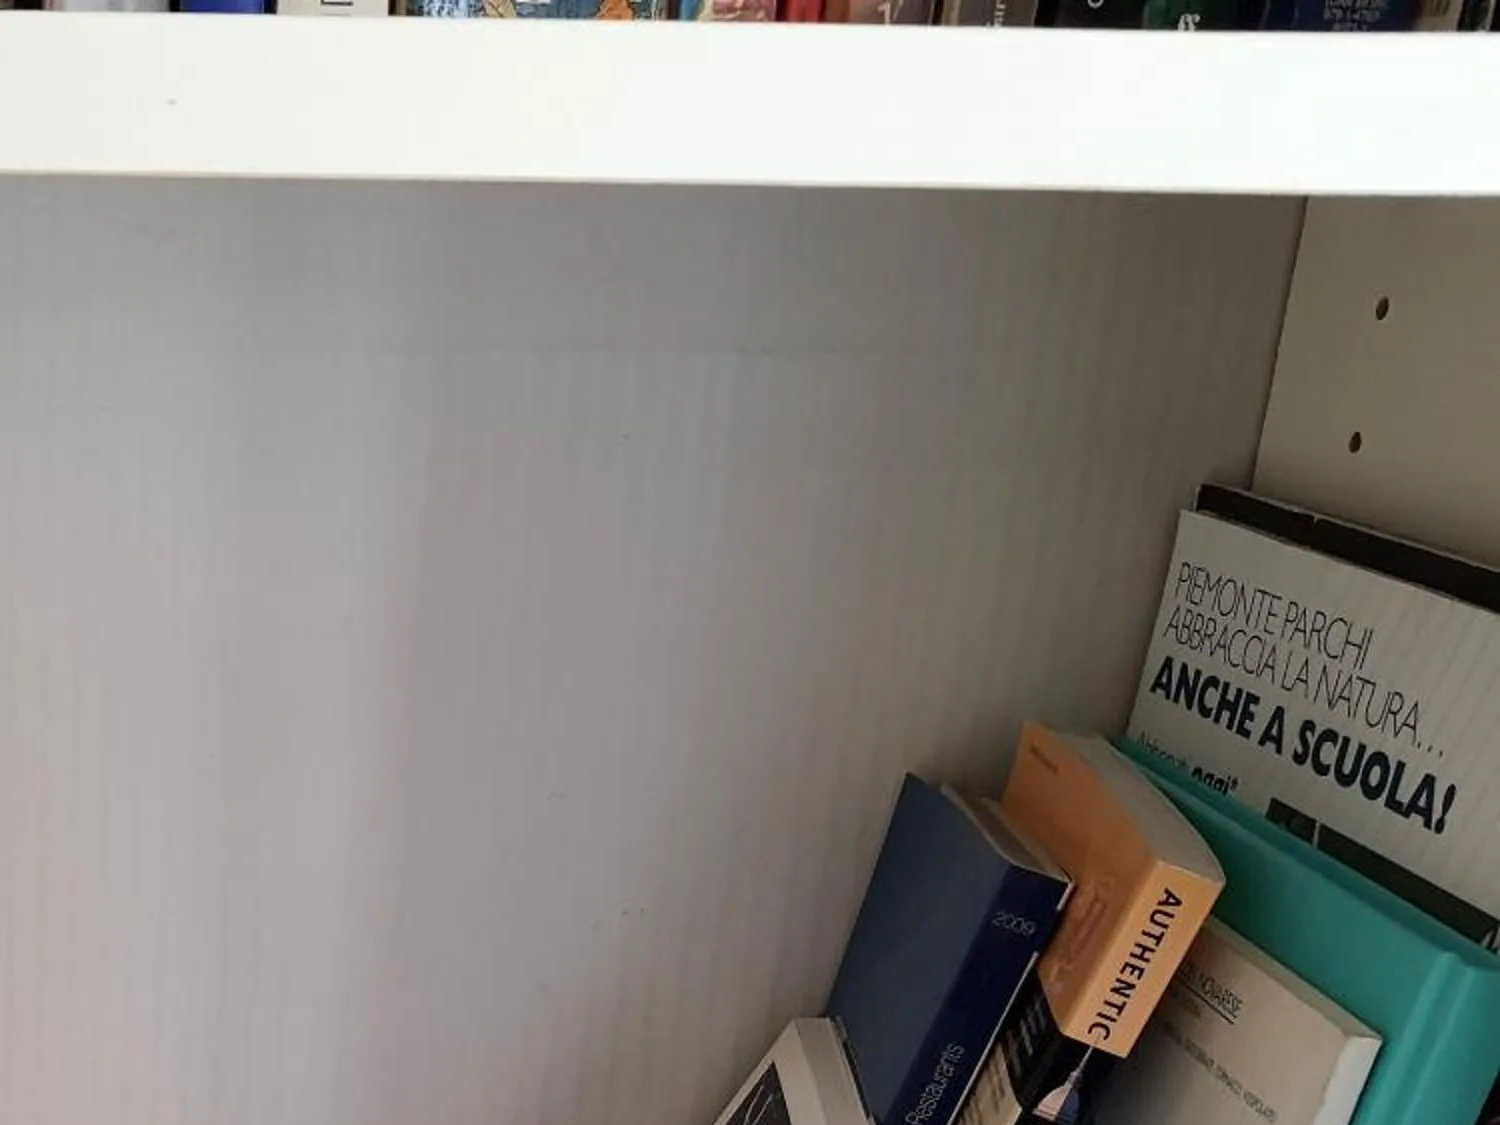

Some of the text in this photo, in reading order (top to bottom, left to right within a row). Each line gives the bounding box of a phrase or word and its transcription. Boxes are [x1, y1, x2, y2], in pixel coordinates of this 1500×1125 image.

[1162, 603, 1277, 686] ABBRACCIA
[1280, 650, 1310, 699] LA
[1174, 561, 1375, 672] PIEMONTE PARCHI
[1149, 655, 1458, 835] ANCHE A SCUOLA!
[1087, 886, 1184, 1042] AUTHENTIC
